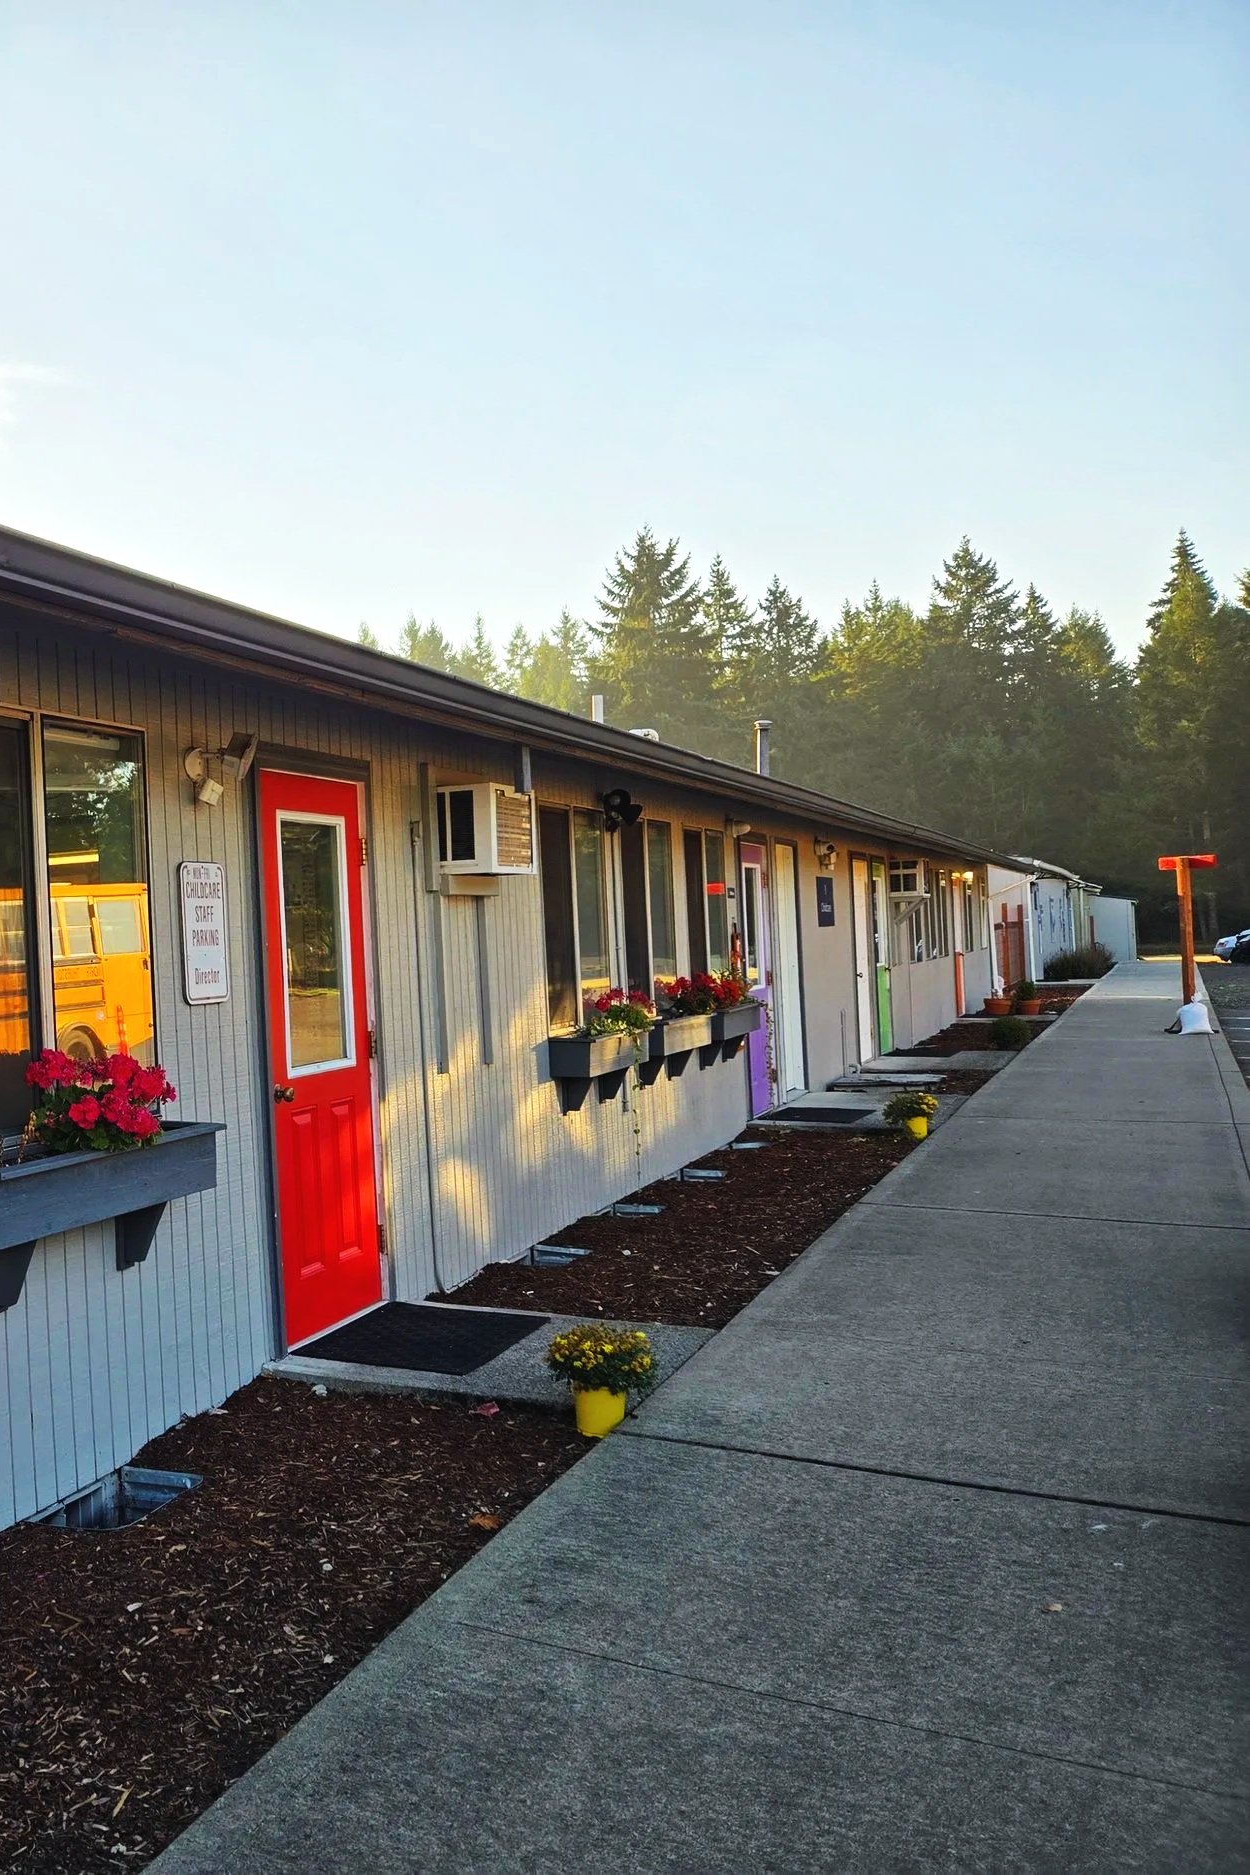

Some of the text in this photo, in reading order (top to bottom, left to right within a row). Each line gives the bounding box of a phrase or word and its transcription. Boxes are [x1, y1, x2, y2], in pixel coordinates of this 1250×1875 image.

[186, 881, 221, 899] CHILDCARE
[195, 906, 214, 923] STAFF
[192, 929, 219, 947] PARKING
[195, 968, 220, 985] Director
